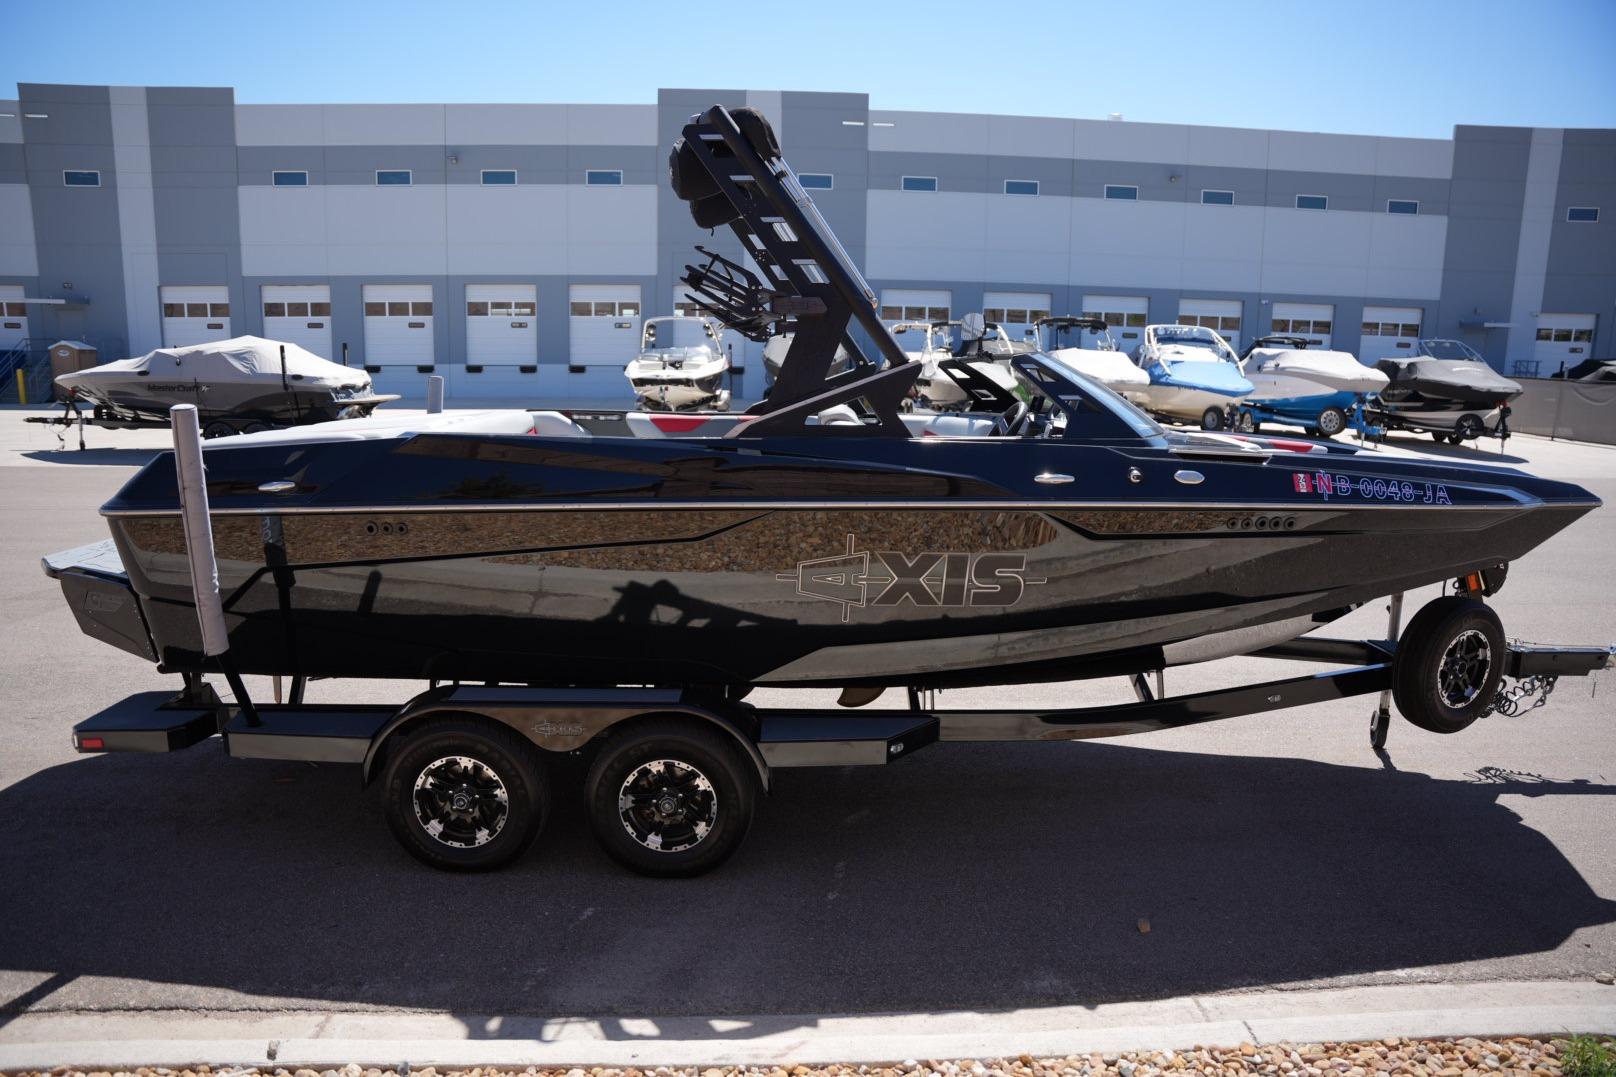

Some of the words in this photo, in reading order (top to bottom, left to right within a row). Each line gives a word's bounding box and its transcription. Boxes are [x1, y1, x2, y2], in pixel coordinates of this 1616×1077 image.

[1359, 477, 1415, 501] 0048
[1423, 483, 1453, 504] JA
[776, 534, 1047, 622] AXIS
